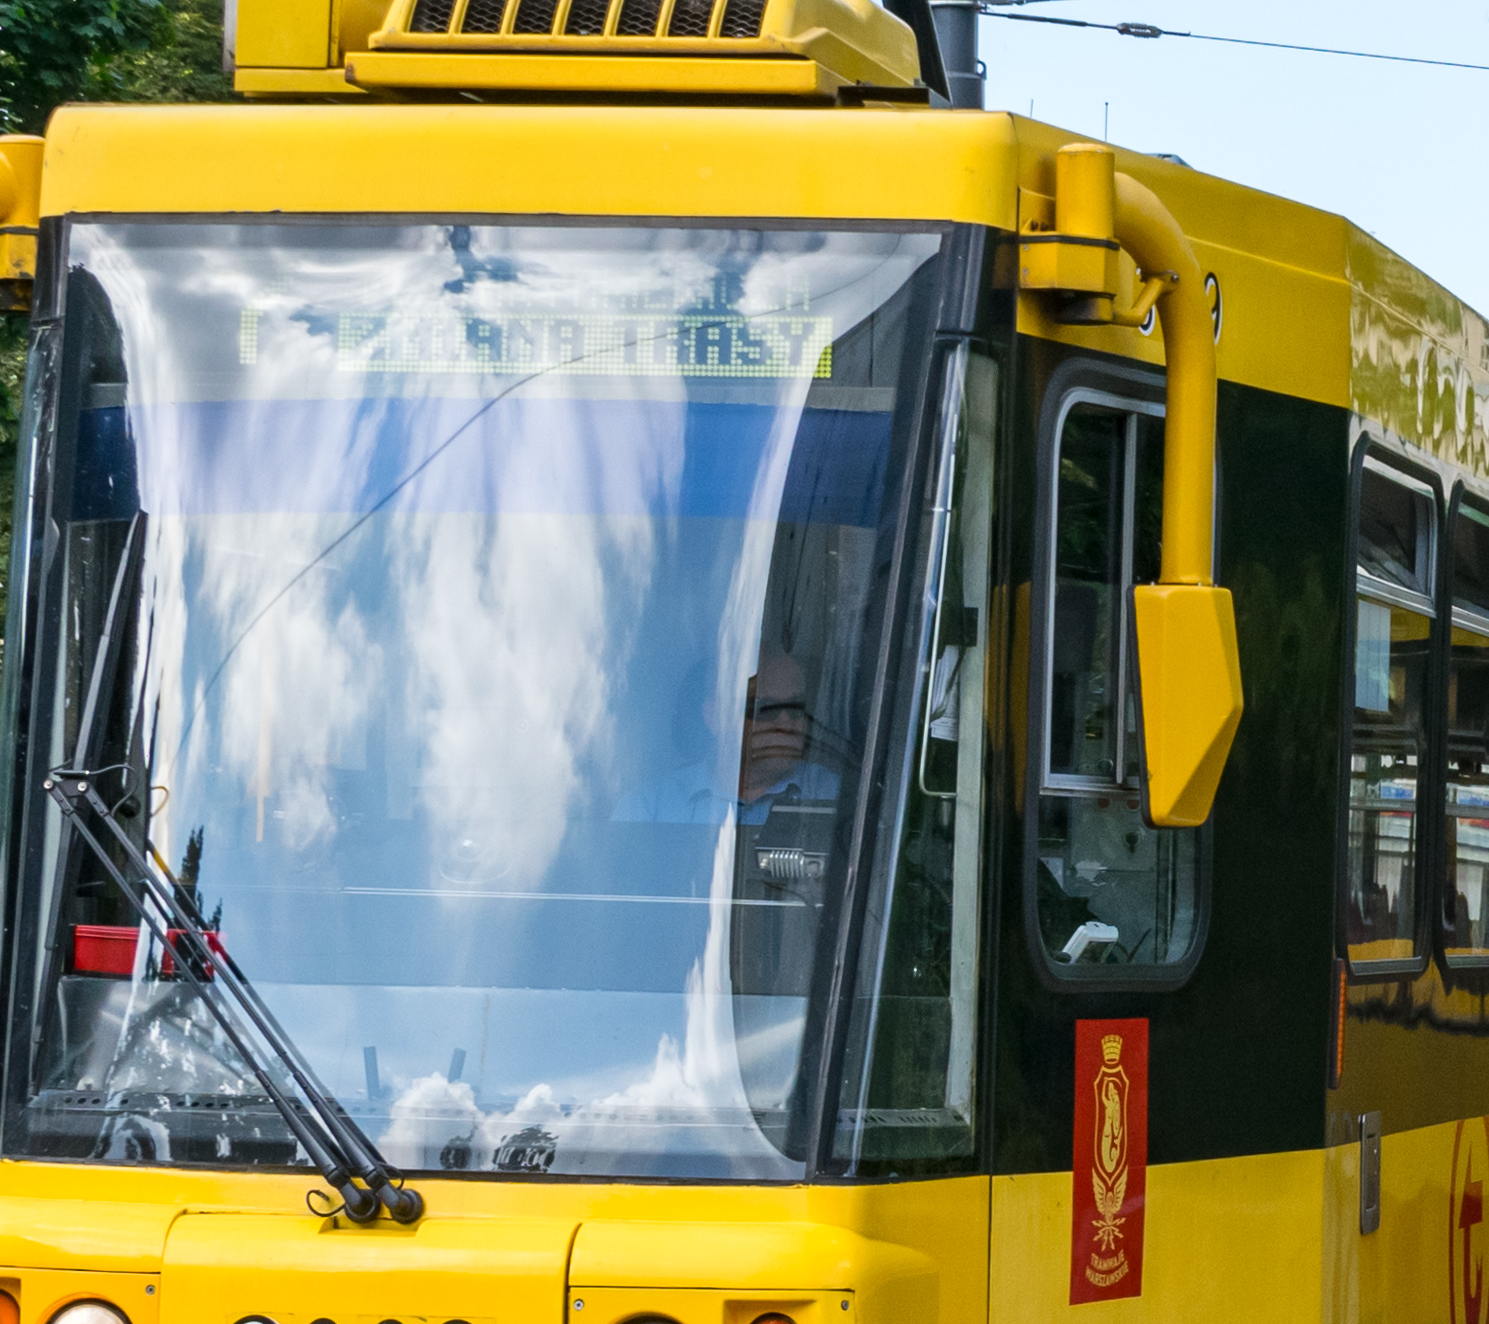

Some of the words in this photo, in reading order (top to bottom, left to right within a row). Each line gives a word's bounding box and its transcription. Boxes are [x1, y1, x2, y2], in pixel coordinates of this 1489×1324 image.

[613, 320, 816, 366] TRASY
[1091, 1249, 1125, 1270] TRAMWAJE
[1085, 1261, 1128, 1286] WARSZAWSKIE
